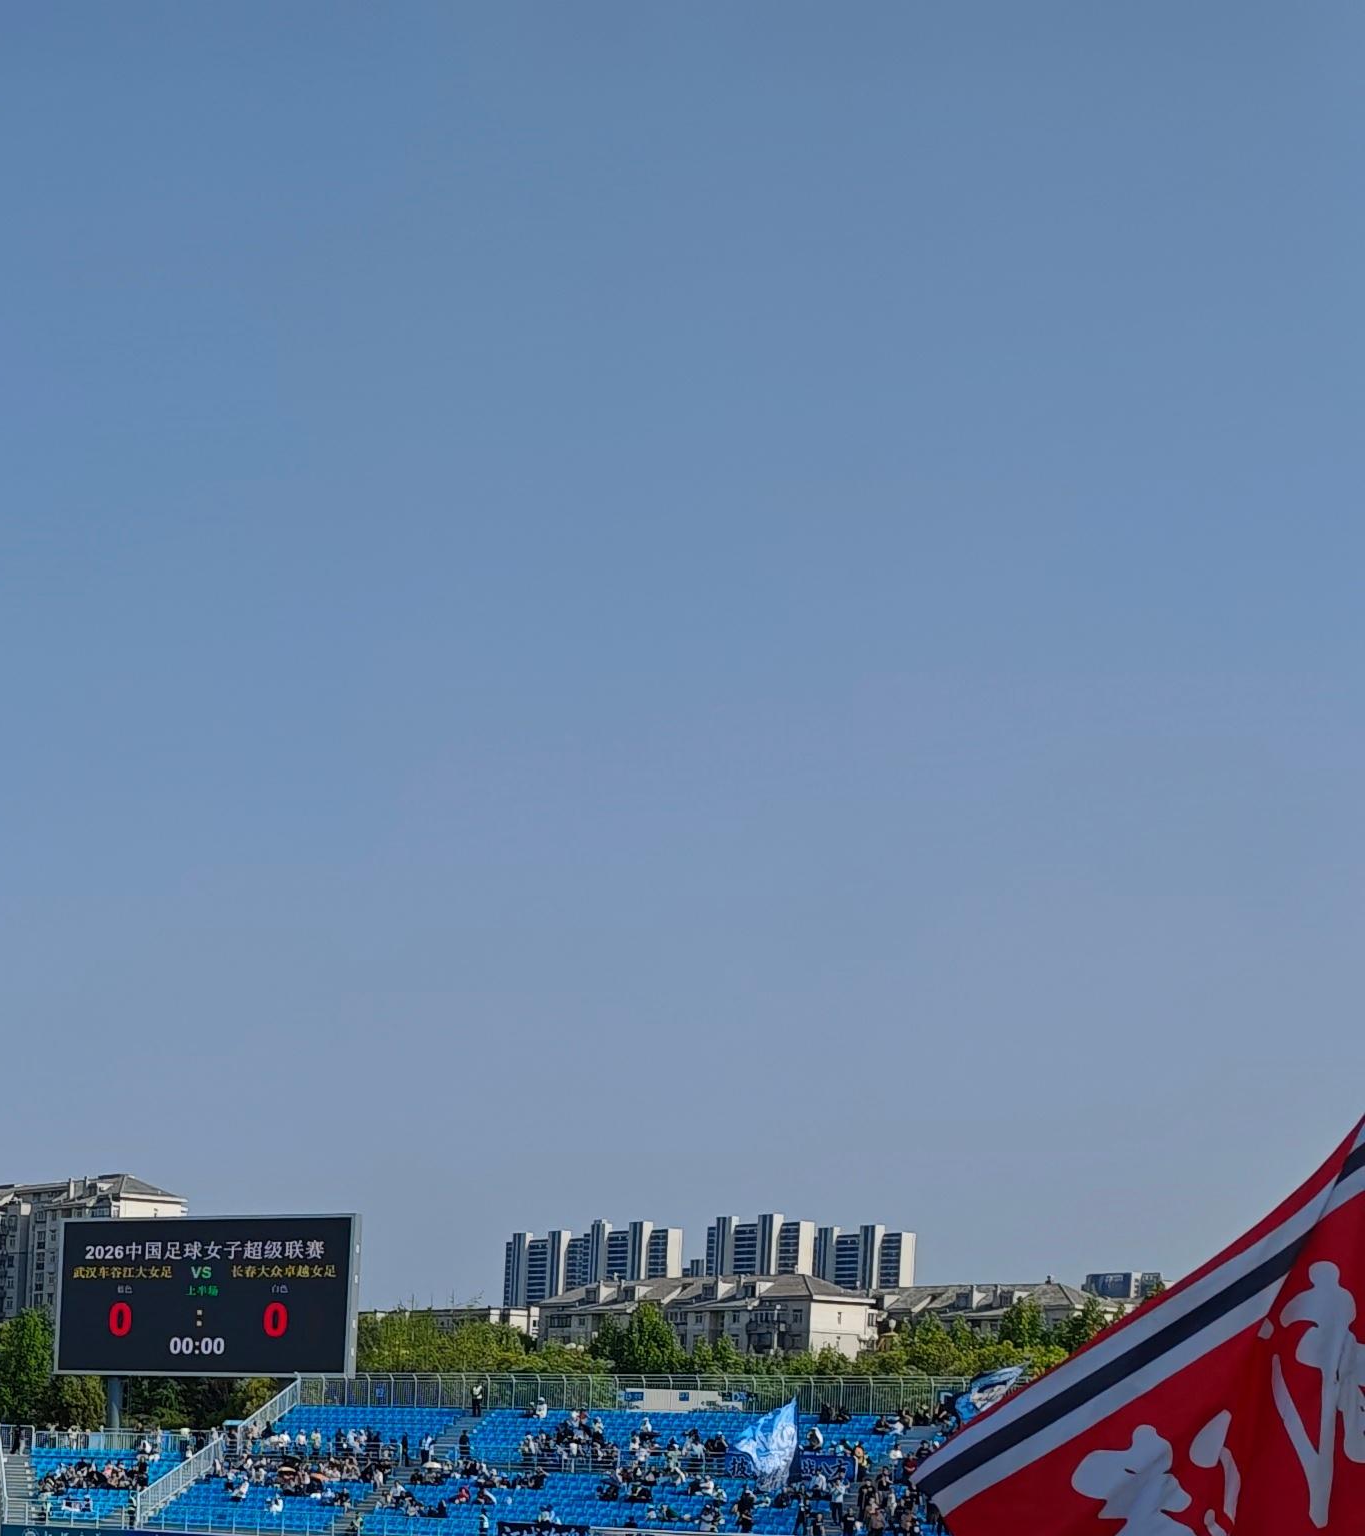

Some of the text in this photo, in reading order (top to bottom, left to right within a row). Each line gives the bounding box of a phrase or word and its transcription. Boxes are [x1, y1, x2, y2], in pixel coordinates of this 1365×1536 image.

[85, 1241, 325, 1260] 2026中国足球女子超级联赛
[73, 1265, 173, 1279] 武汉车谷江大女足
[191, 1266, 212, 1279] VS
[231, 1264, 337, 1278] 长春大众卓越女足
[108, 1302, 132, 1338] 0
[263, 1302, 288, 1338] 0
[169, 1337, 225, 1355] 00:00
